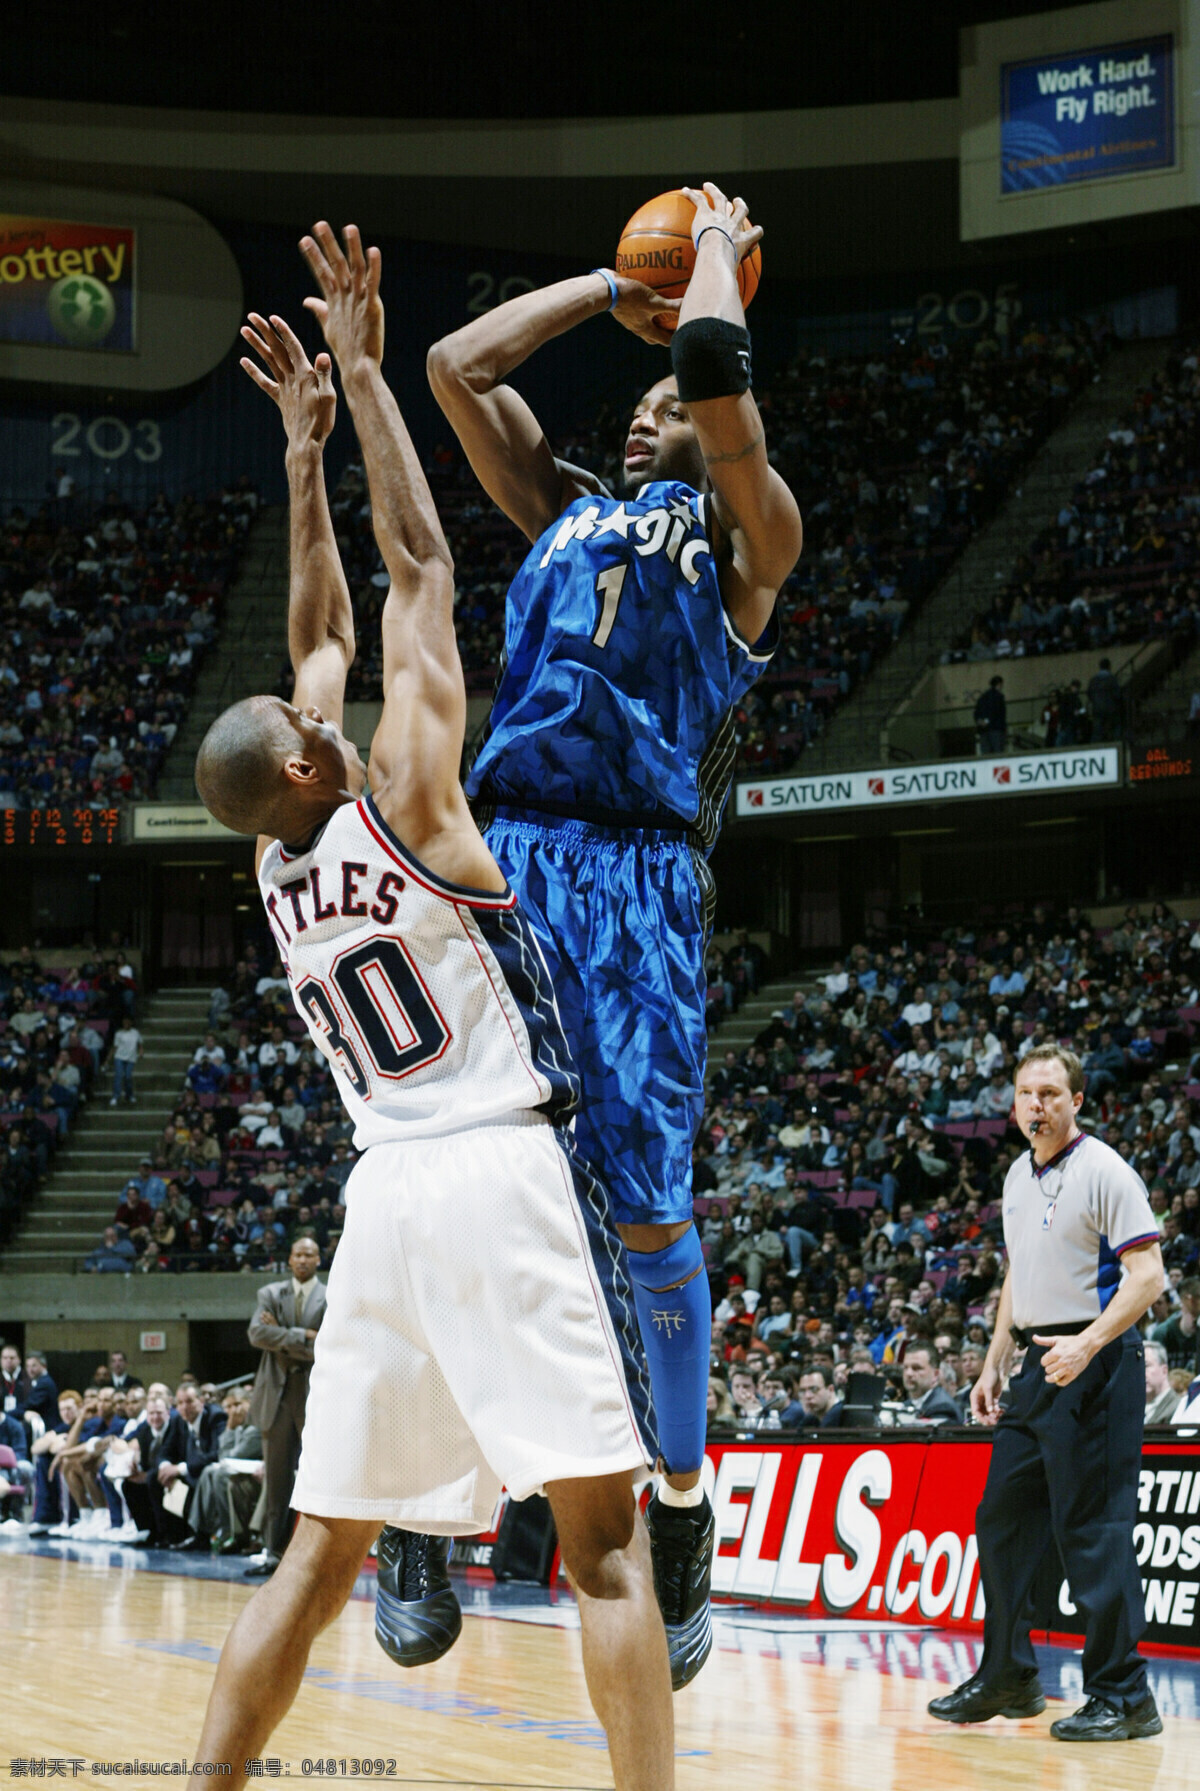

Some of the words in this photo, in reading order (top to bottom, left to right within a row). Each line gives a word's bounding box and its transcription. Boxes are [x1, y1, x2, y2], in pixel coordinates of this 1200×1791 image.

[1037, 65, 1094, 95] Work
[1099, 54, 1156, 84] Hard.
[1056, 96, 1088, 123] Fly
[1093, 85, 1156, 116] Right.
[0, 242, 126, 283] ottery
[617, 246, 683, 271] PALDING
[51, 413, 162, 462] 203
[592, 564, 628, 649] 1
[771, 781, 852, 806] SATURN
[892, 769, 976, 794] SATURN
[1018, 757, 1105, 783] SATURN
[295, 934, 453, 1102] 30
